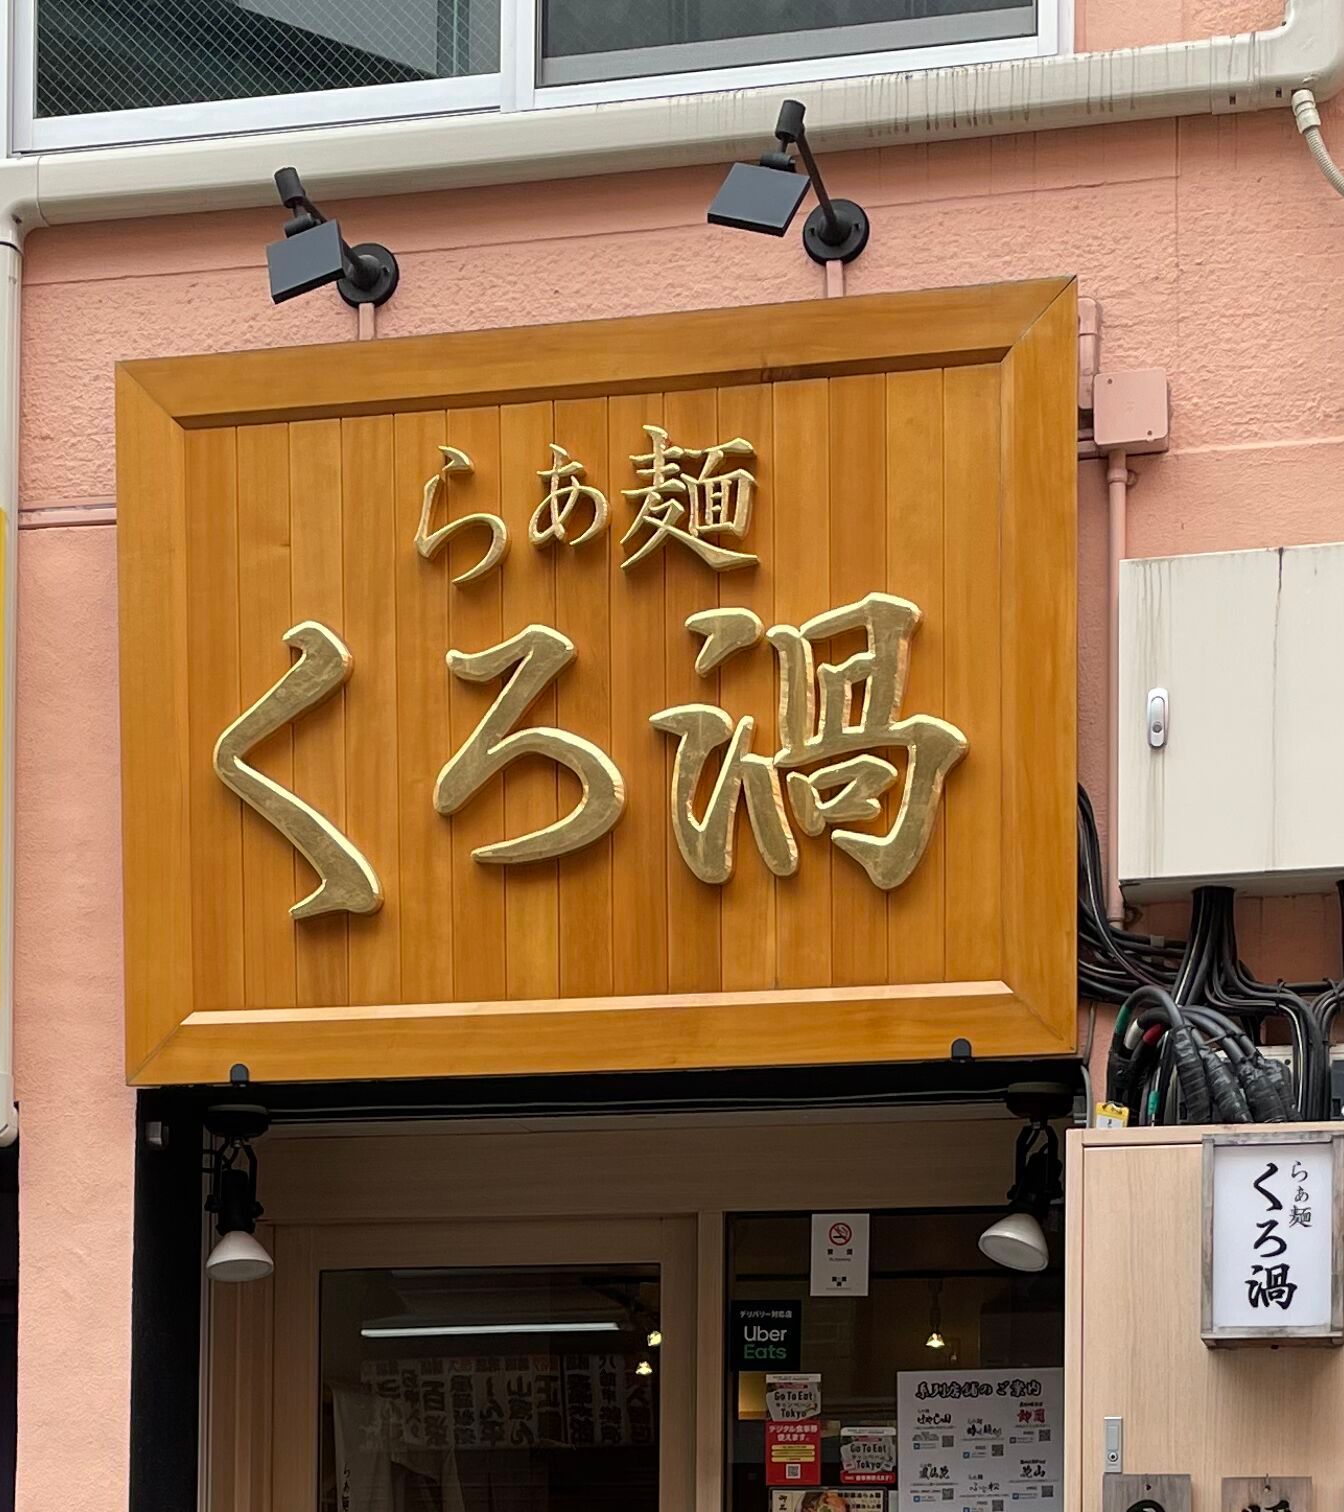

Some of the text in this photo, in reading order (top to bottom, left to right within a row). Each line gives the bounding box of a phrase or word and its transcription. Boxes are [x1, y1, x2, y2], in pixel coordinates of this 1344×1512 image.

[413, 423, 762, 586] らぁ麺
[212, 591, 971, 922] くろ渦
[1289, 1160, 1313, 1228] らぁ麺
[1244, 1162, 1298, 1310] くろ渦
[743, 1325, 788, 1342] Uber
[743, 1343, 788, 1360] Eats
[774, 1391, 813, 1401] Go To Eat
[781, 1408, 808, 1419] Tokyo
[856, 1460, 881, 1470] Tokyo
